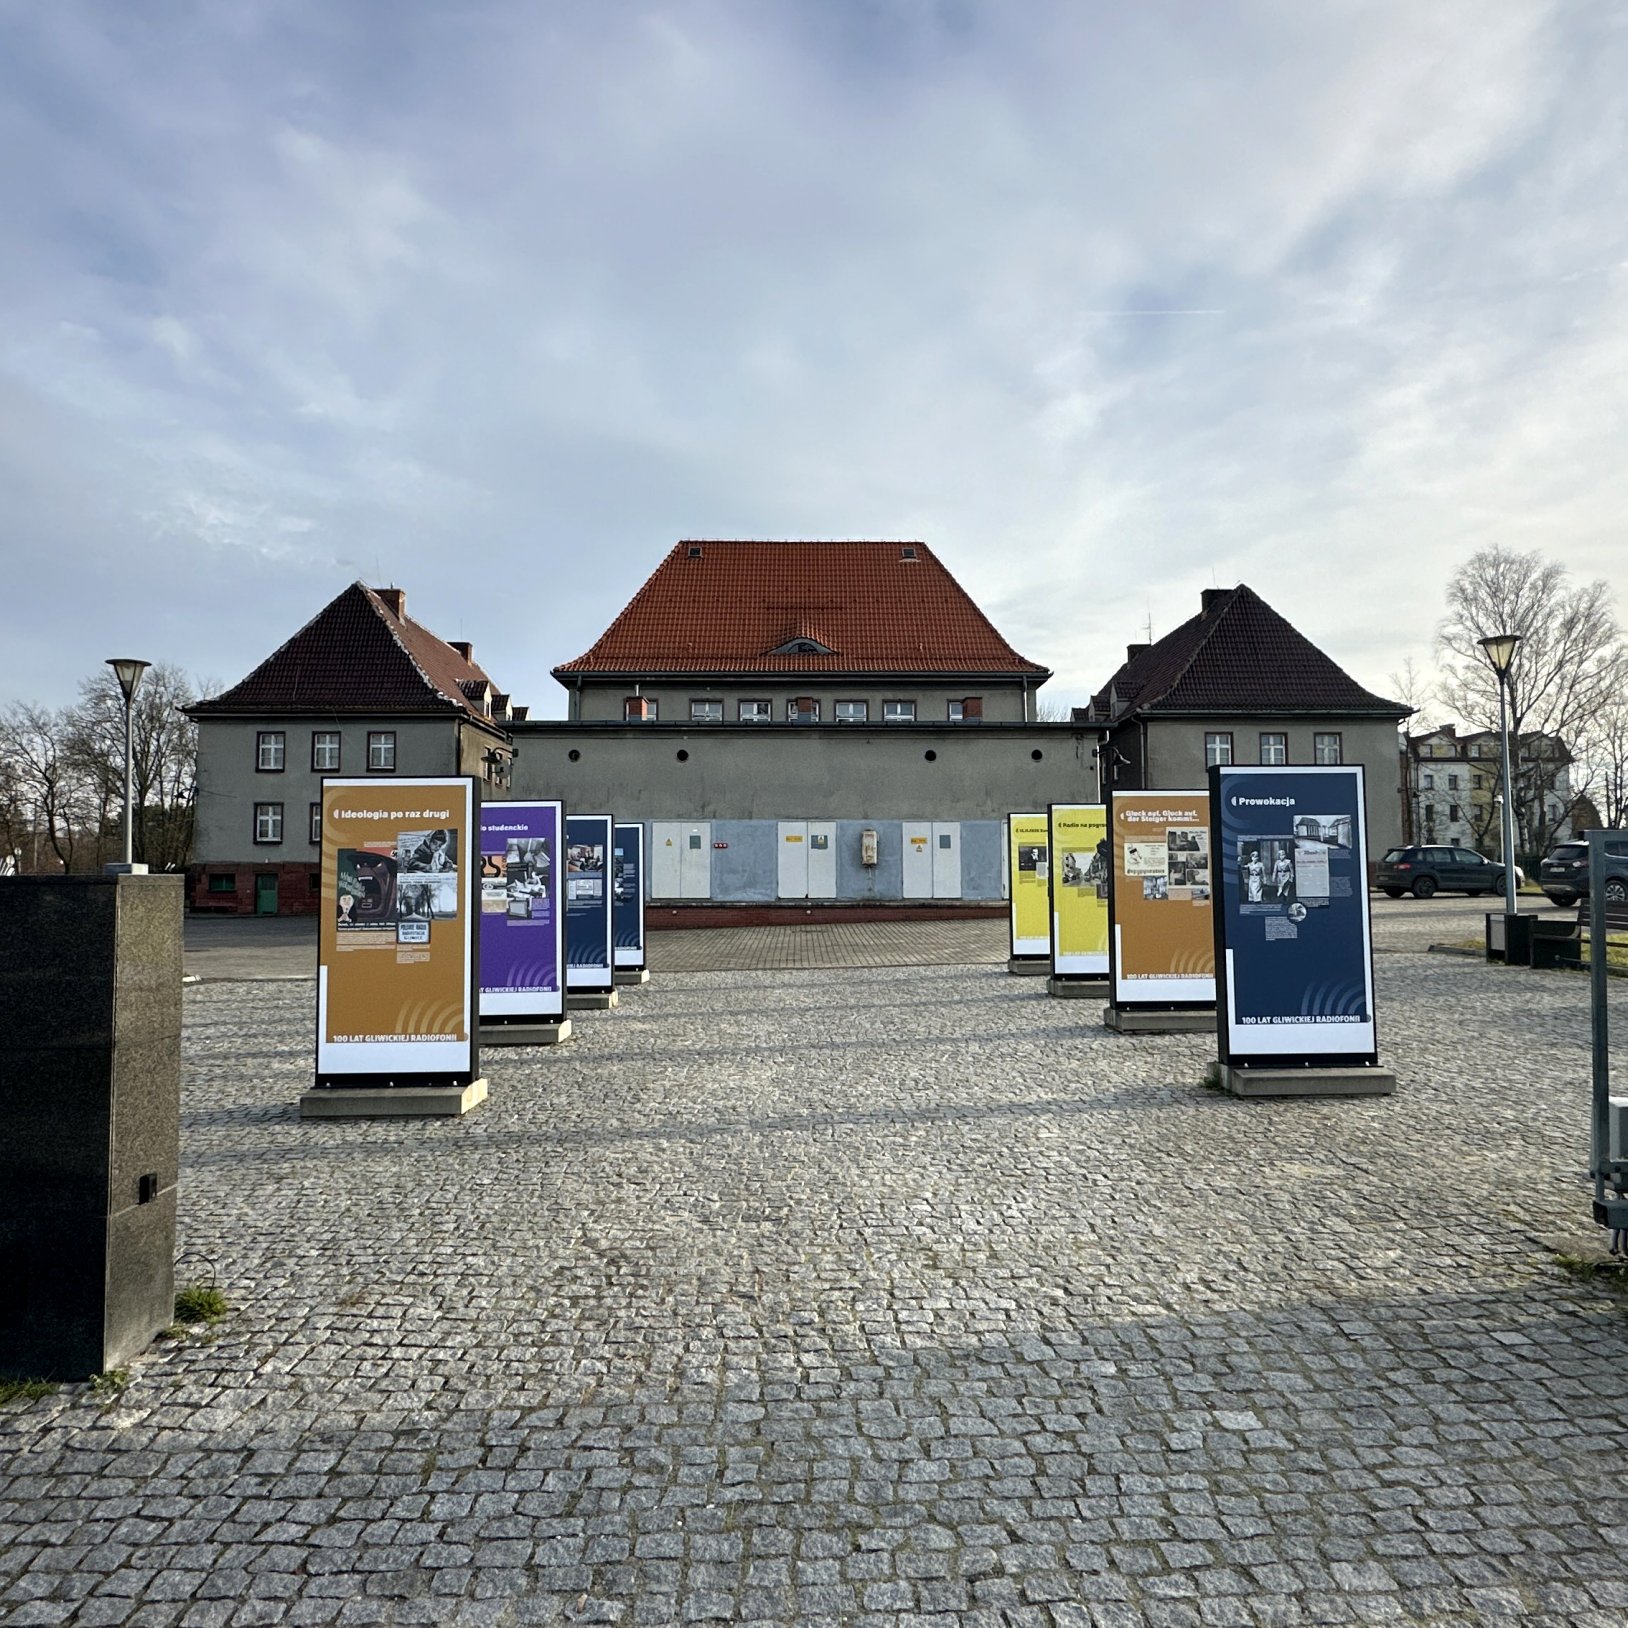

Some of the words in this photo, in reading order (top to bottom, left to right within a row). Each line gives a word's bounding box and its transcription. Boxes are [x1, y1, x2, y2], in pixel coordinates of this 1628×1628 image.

[1239, 797, 1295, 807] Prowokacja
[341, 810, 389, 820] Ideologia
[391, 811, 403, 819] po
[423, 809, 449, 819] drugi
[1242, 1016, 1256, 1024] 100
[1257, 1016, 1271, 1024] LAT
[1272, 1016, 1314, 1024] GLIWICKIEJ
[1316, 1015, 1361, 1023] RADIOFONII
[365, 1034, 409, 1042] GLIWICKIEJ
[411, 1034, 457, 1042] RADIOFONII
